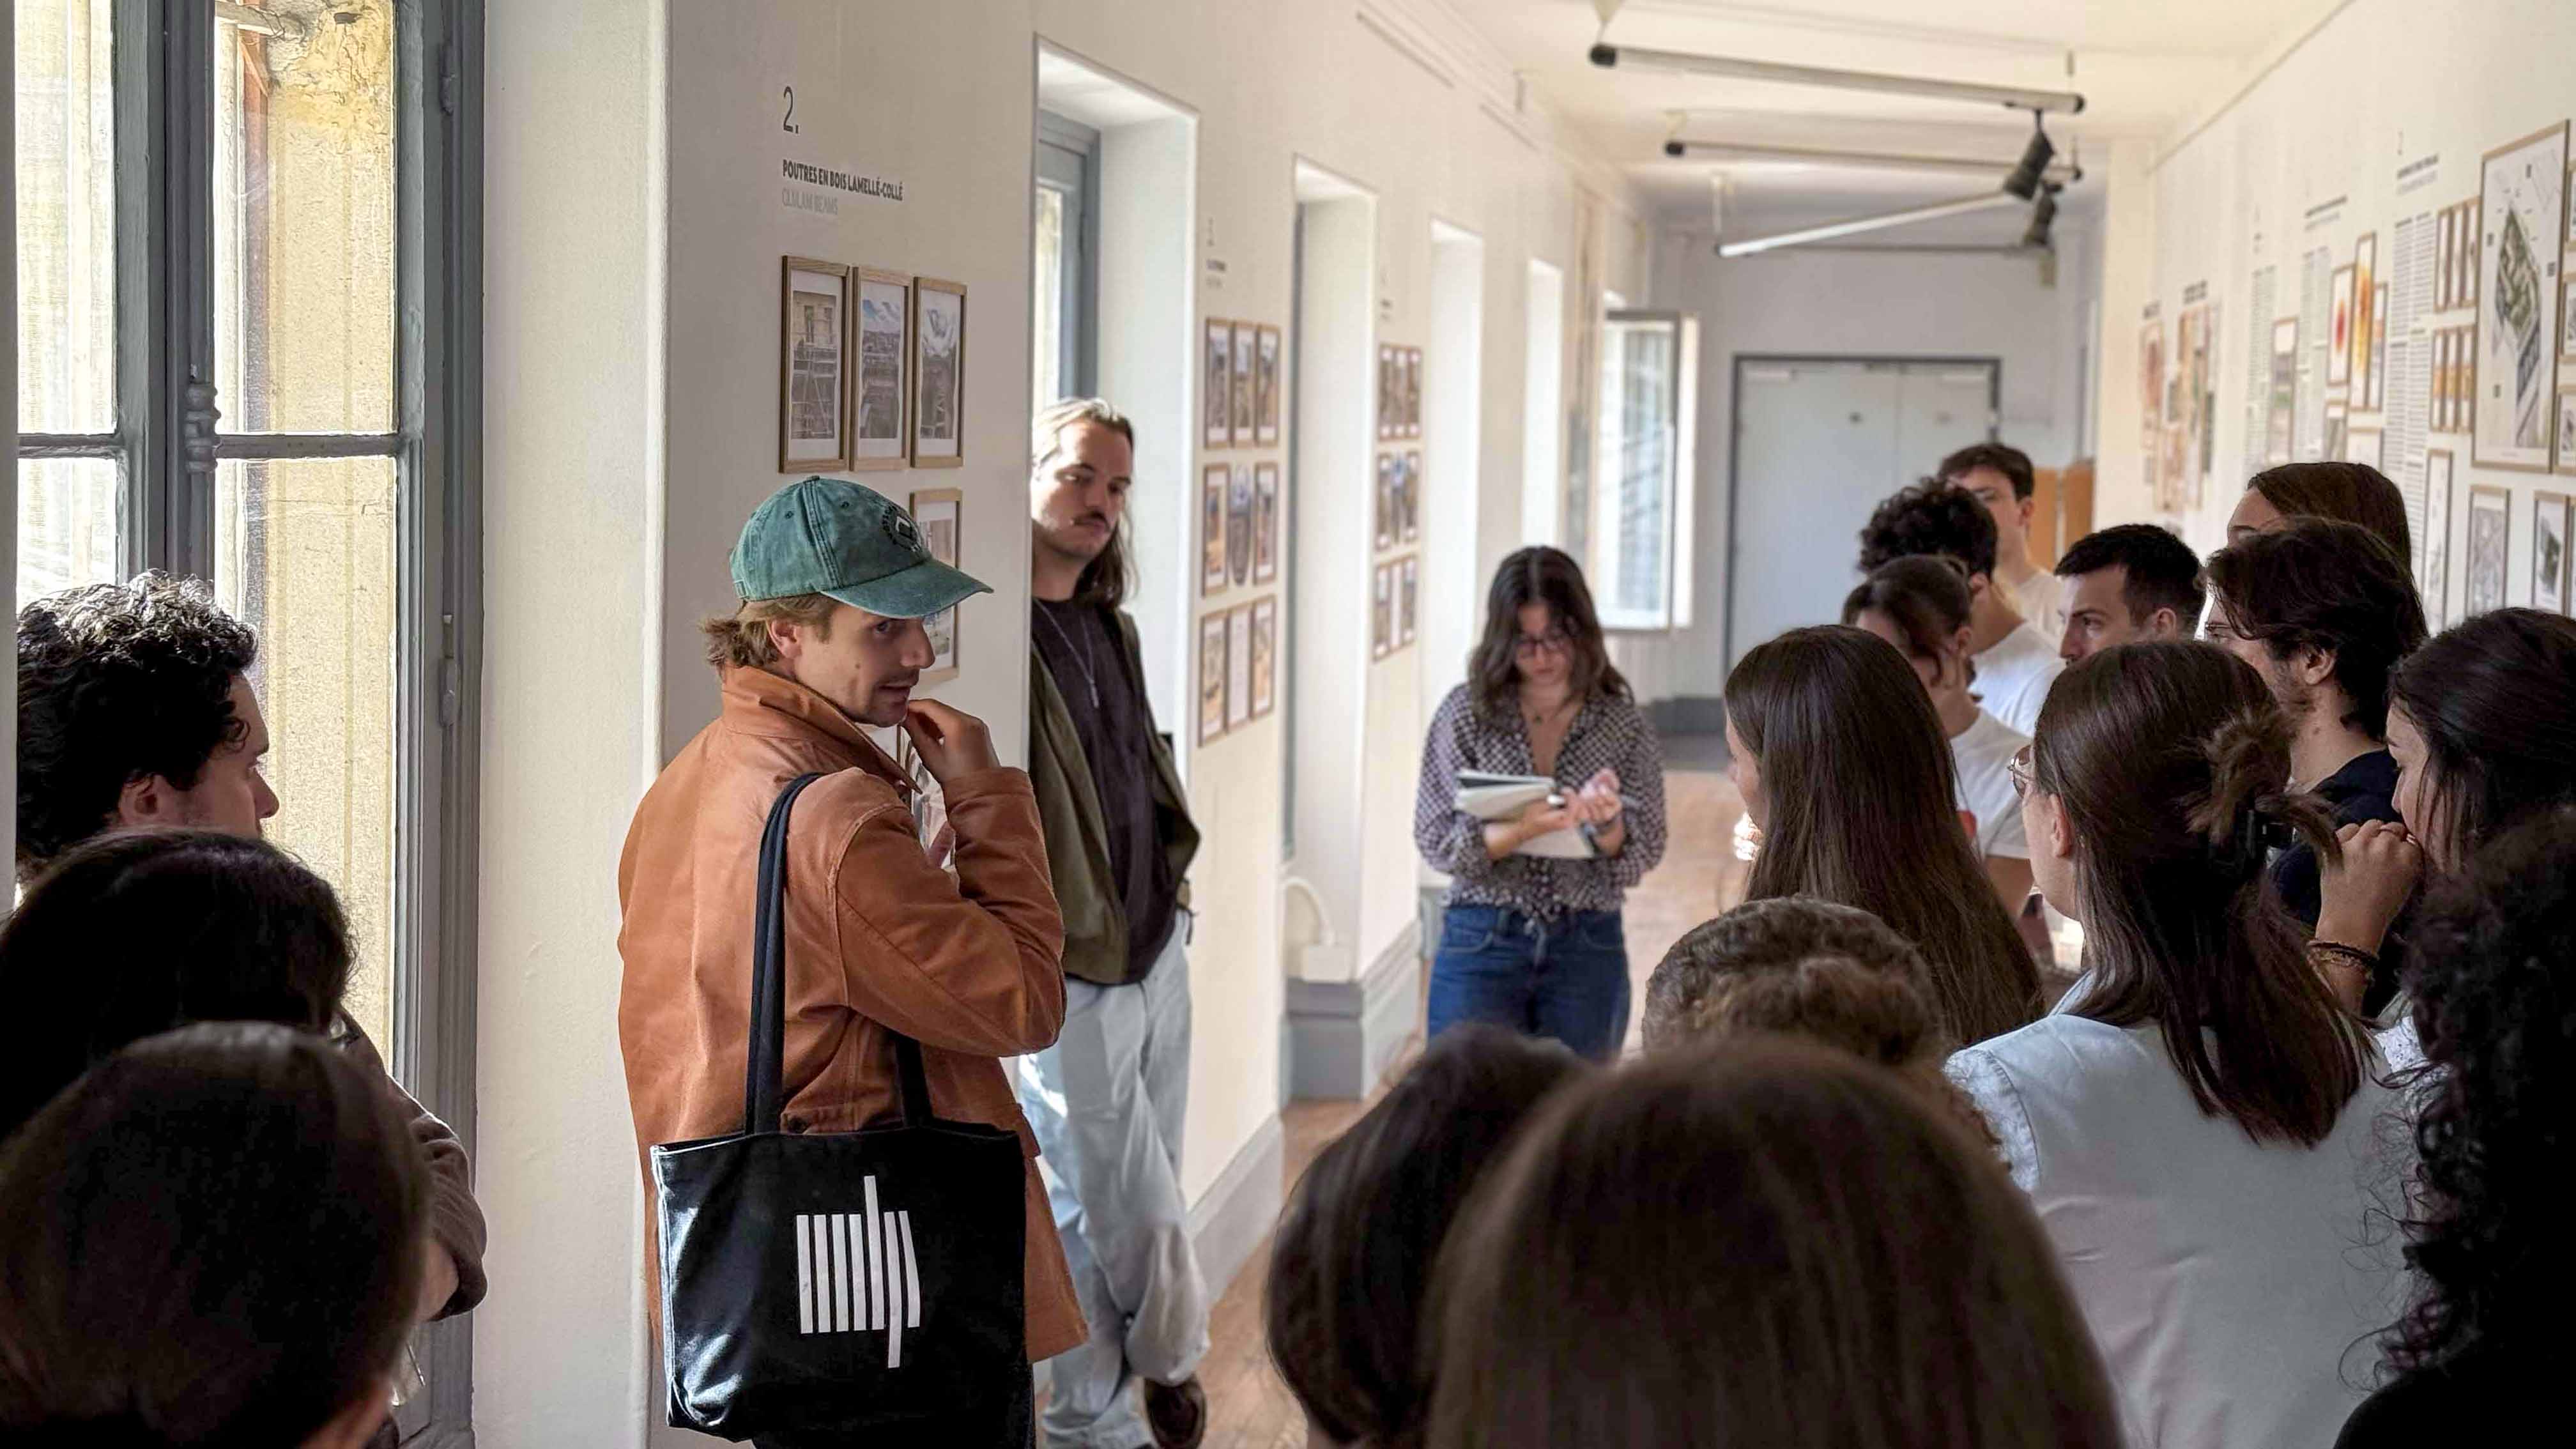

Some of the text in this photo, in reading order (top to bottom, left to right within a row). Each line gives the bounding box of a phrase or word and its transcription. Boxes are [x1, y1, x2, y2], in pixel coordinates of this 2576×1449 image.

[783, 86, 799, 134] 2.
[782, 159, 903, 201] POUTRES EN BOIS LAMELLÉ-COLLÉ
